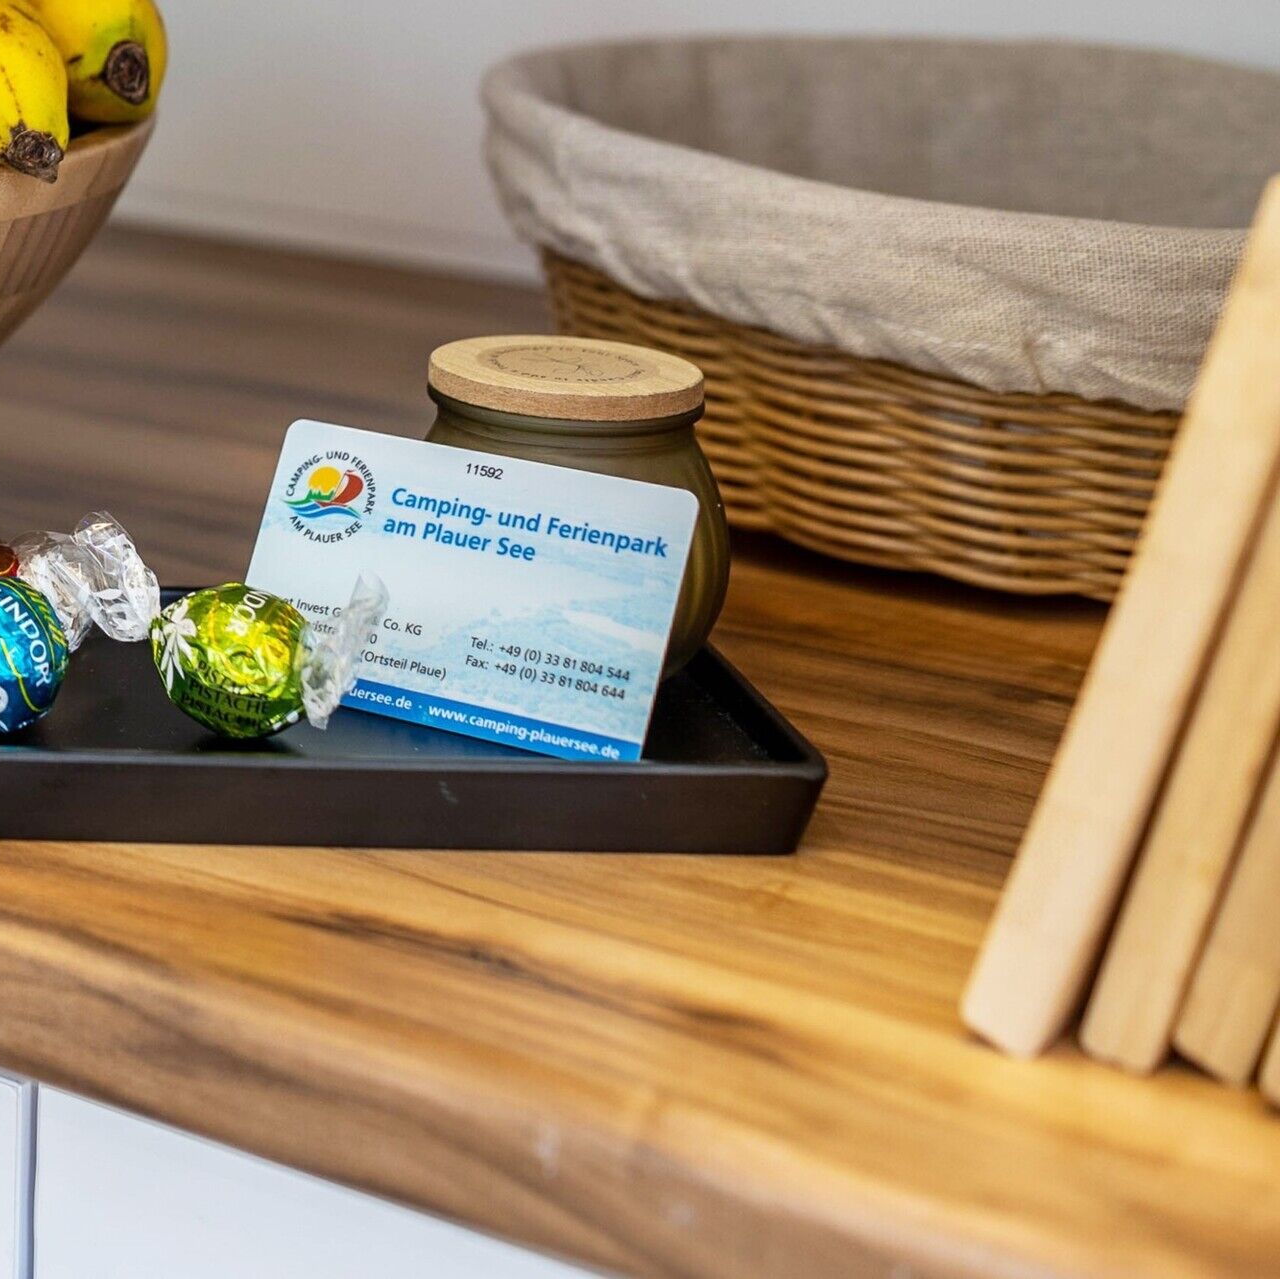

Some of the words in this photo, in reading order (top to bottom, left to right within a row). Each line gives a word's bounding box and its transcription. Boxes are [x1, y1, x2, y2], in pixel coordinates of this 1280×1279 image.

[286, 454, 324, 497] CAMPING-
[326, 451, 350, 461] UND
[350, 456, 377, 515] FERIENPARK
[466, 463, 504, 480] 11592
[289, 515, 305, 532] AM
[303, 528, 344, 543] PLAUER
[344, 520, 363, 538] SEE
[383, 517, 417, 537] am
[422, 522, 492, 553] Plauer
[496, 537, 537, 562] See
[391, 487, 492, 526] Camping-
[498, 509, 542, 532] und
[547, 517, 669, 558] Ferienpark
[296, 599, 330, 616] Invest
[383, 618, 401, 631] Co.
[405, 622, 423, 636] KG
[360, 649, 408, 670] (Ortsteil
[410, 661, 447, 681] Plaue)
[465, 655, 490, 669] Fax:
[494, 662, 516, 676] +49
[519, 666, 537, 682] (0)
[540, 671, 555, 684] 33
[558, 675, 572, 688] 81
[575, 679, 598, 693] 804
[601, 685, 625, 699] 644
[471, 636, 494, 652] Tel.:
[499, 645, 521, 657] +49
[524, 648, 541, 664] (0)
[545, 653, 560, 666] 33
[563, 657, 577, 669] 81
[580, 661, 603, 676] 804
[606, 667, 630, 681] 544
[428, 705, 621, 761] www.camping-plauersee.de
